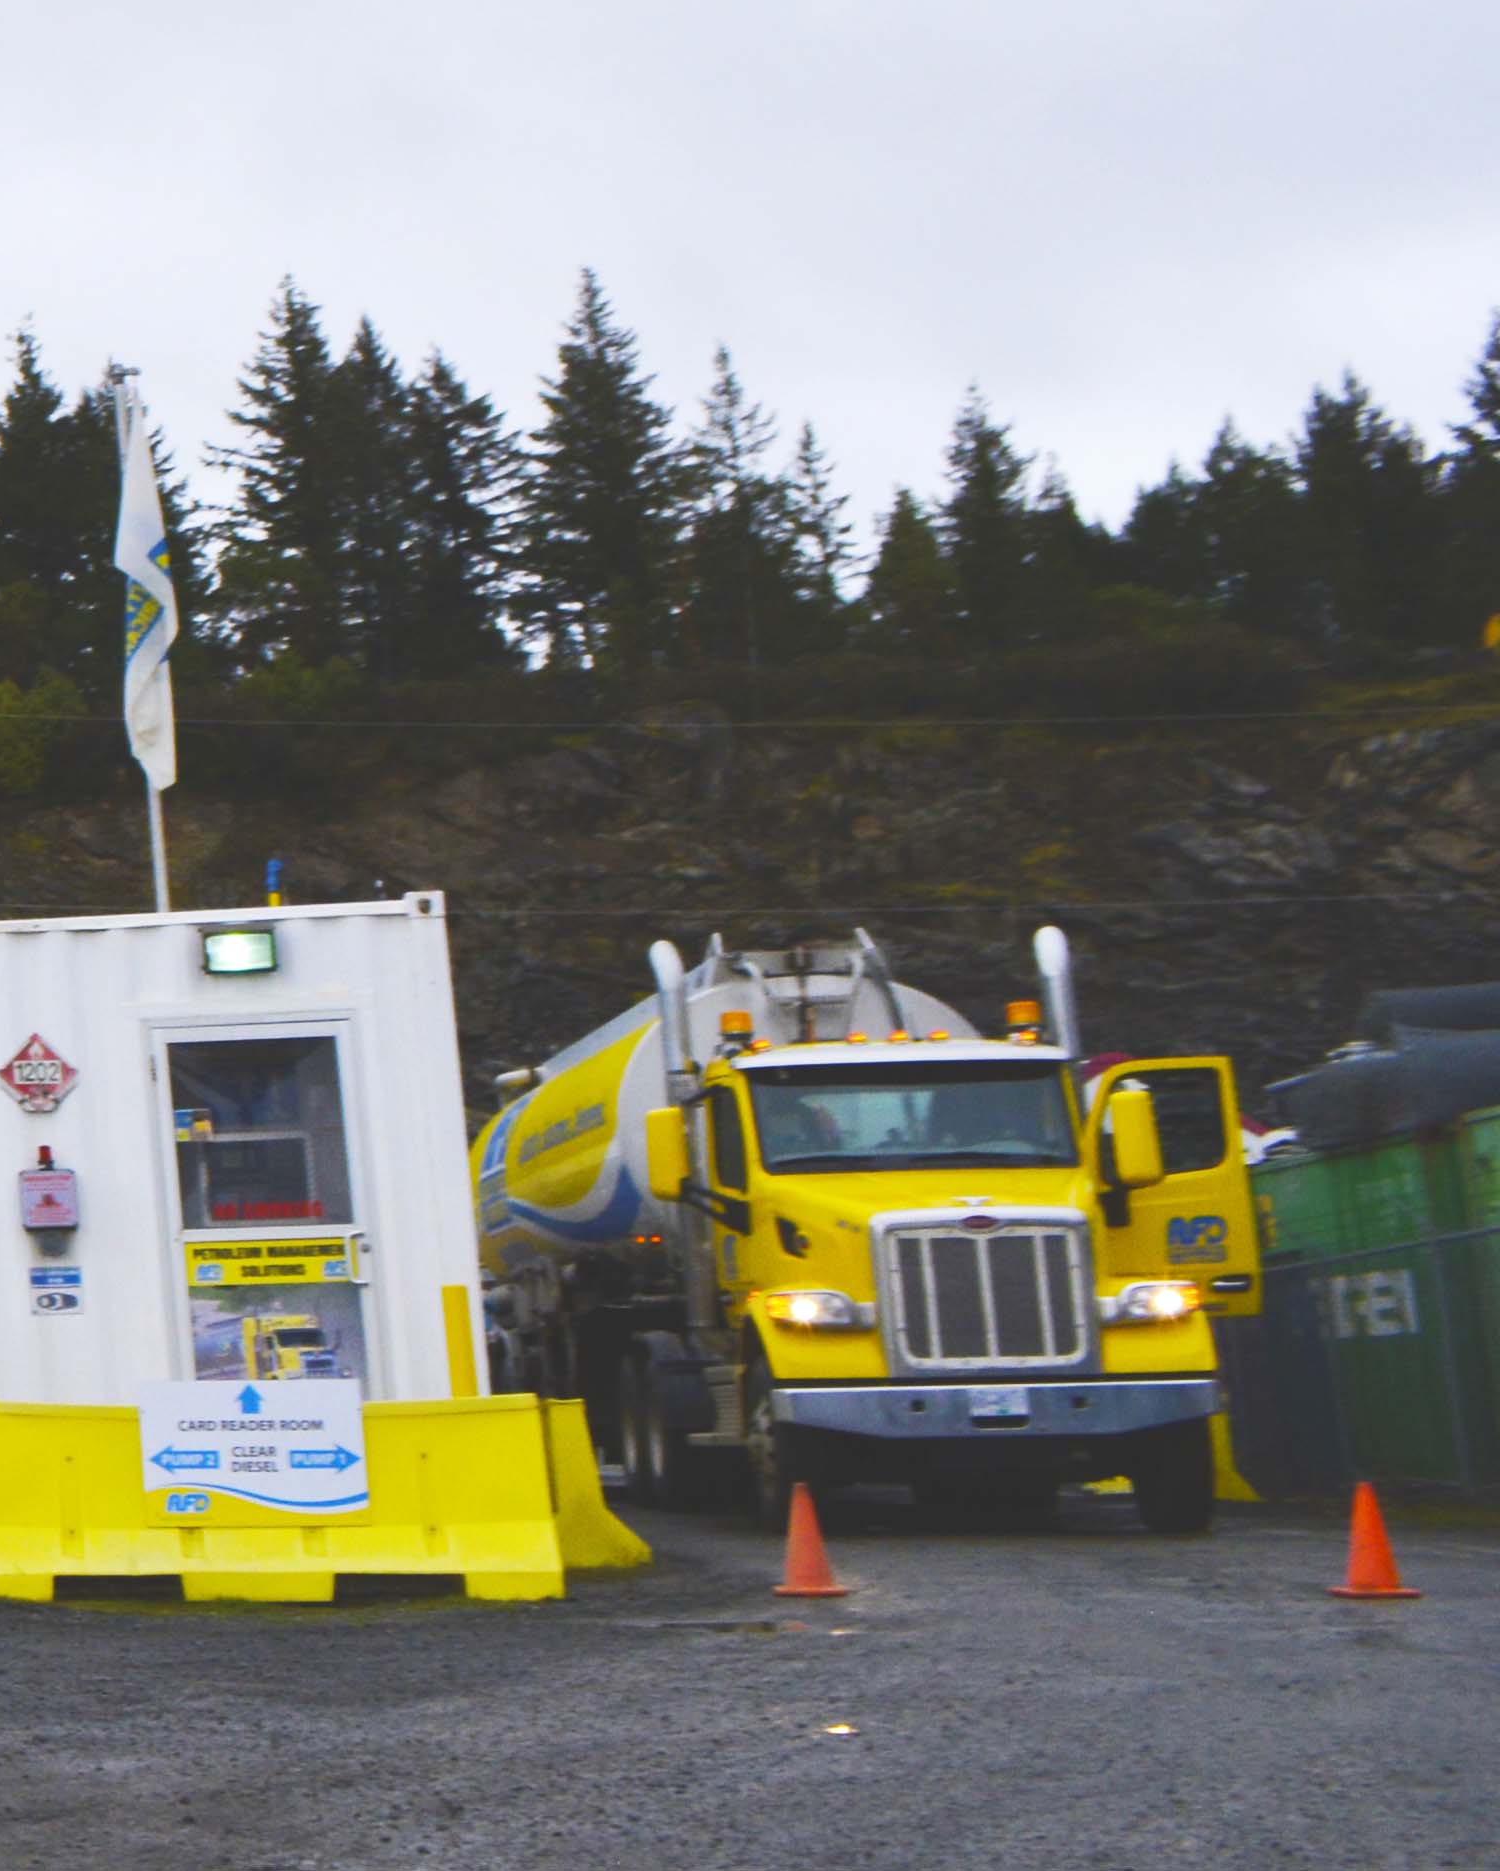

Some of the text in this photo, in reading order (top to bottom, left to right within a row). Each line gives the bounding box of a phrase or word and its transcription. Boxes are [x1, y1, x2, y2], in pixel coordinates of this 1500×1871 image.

[15, 1062, 60, 1082] 1202
[193, 1243, 345, 1260] PETROLEUM MANAGEMEN
[241, 1264, 306, 1277] SOLUTIONS
[178, 1419, 325, 1431] CARD READER ROOM
[231, 1446, 277, 1457] CLEAR
[160, 1453, 215, 1466] PUMP 2
[292, 1453, 333, 1466] PUMP
[231, 1461, 279, 1473] DIESEL
[166, 1492, 211, 1513] AFD
